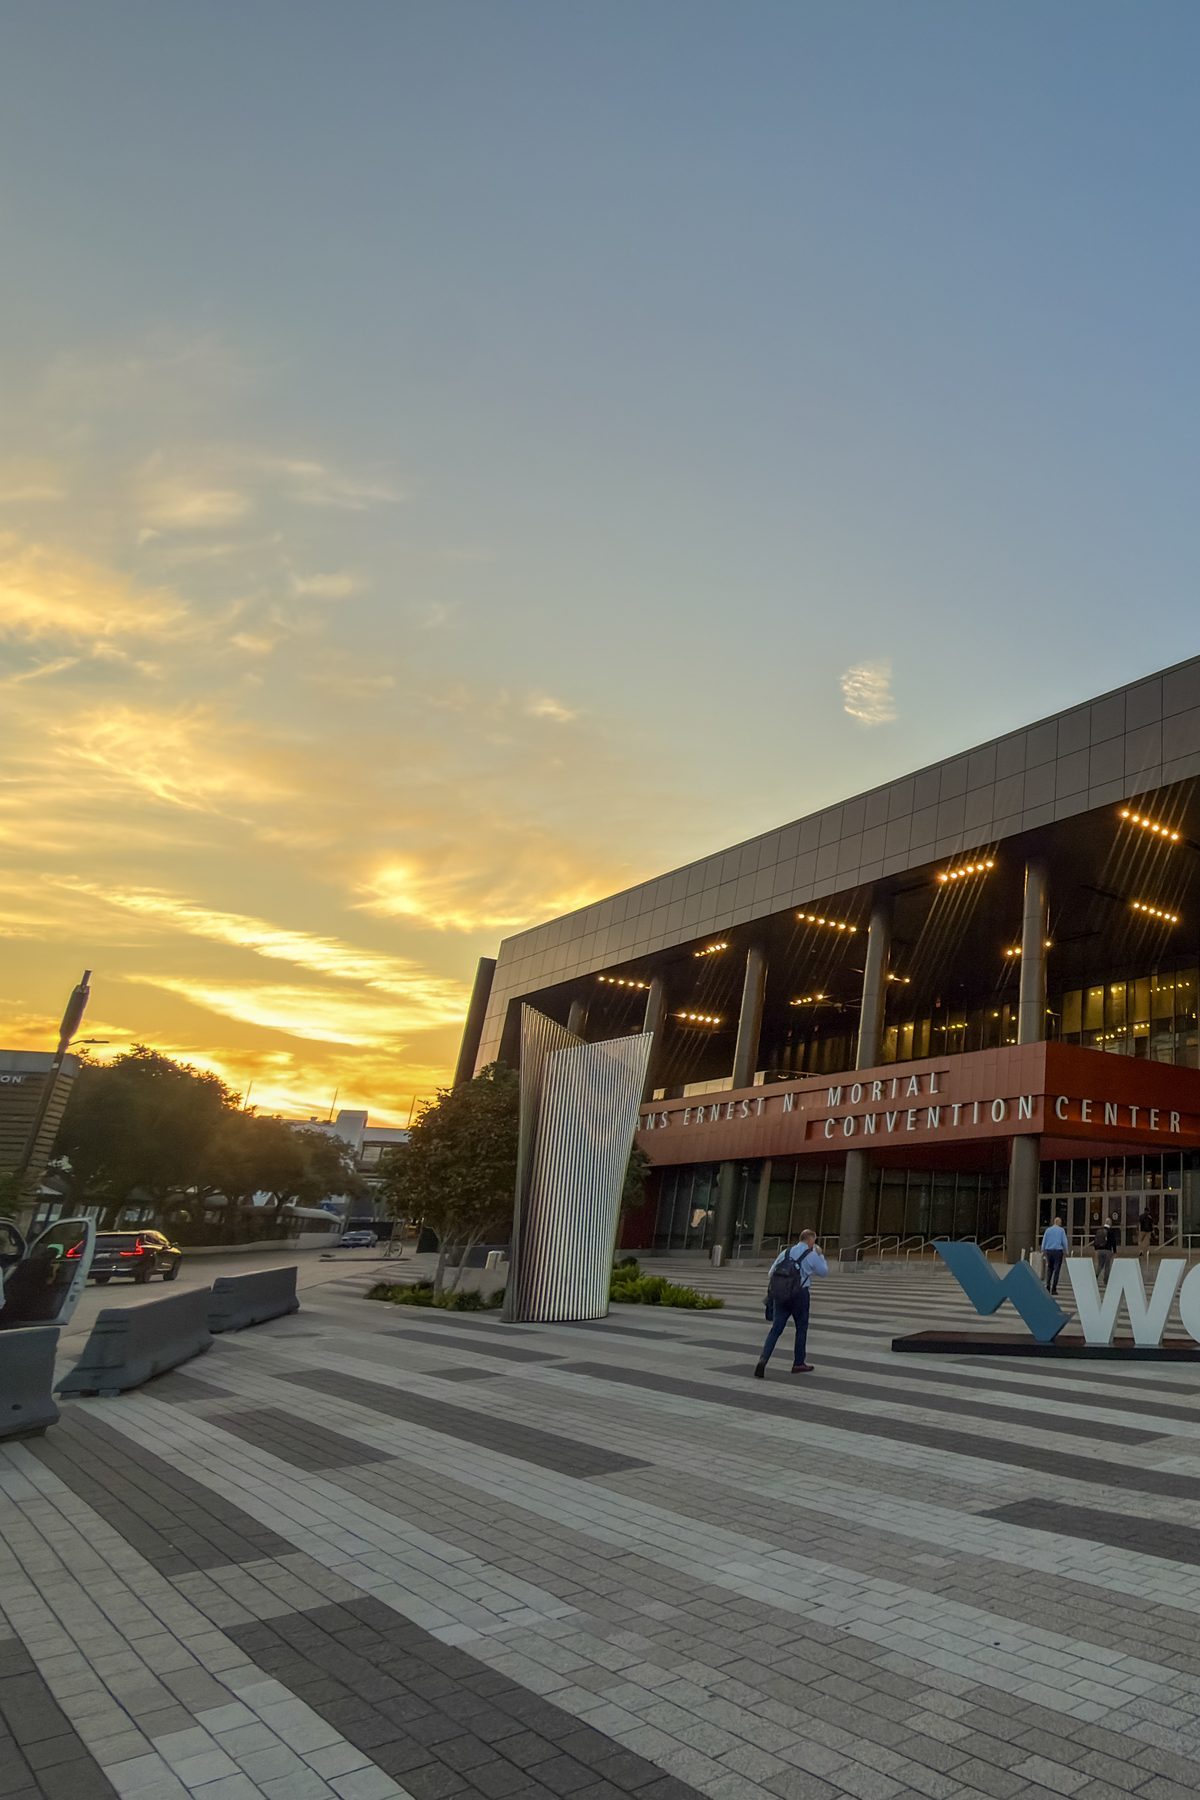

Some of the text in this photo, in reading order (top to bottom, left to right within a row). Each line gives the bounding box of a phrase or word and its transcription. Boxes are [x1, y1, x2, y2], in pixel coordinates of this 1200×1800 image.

[683, 1096, 765, 1126] ERNEST
[782, 1092, 805, 1113] N.
[827, 1072, 939, 1108] MORIAL
[823, 1095, 1181, 1140] CONVENTION CENTER
